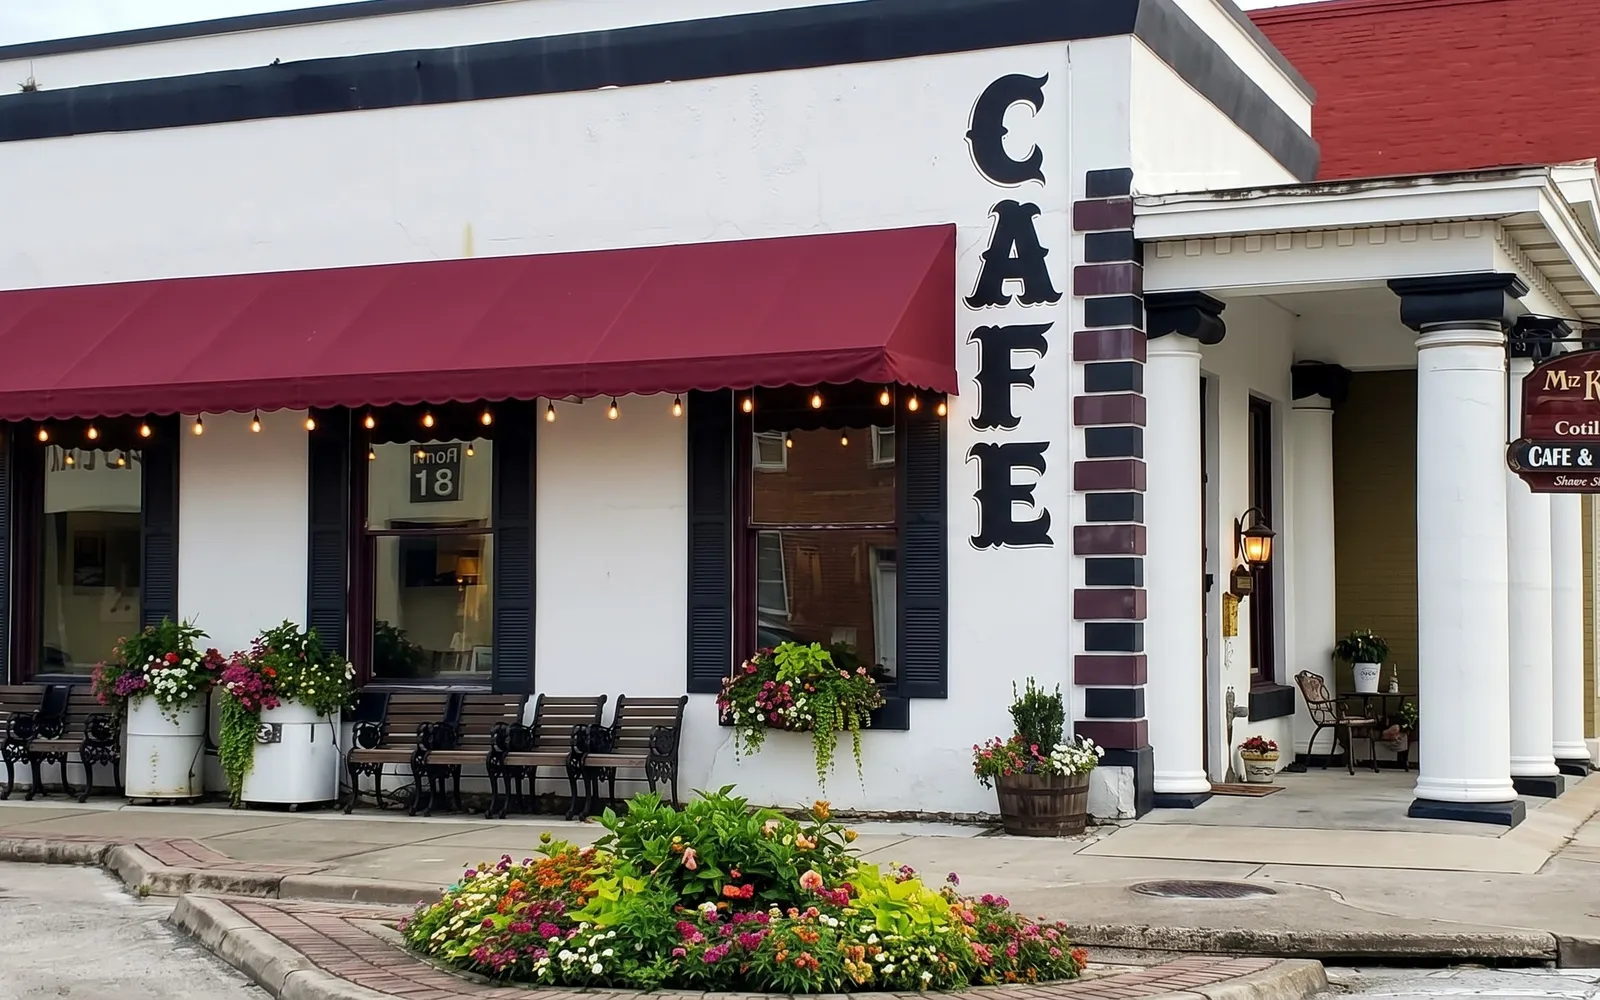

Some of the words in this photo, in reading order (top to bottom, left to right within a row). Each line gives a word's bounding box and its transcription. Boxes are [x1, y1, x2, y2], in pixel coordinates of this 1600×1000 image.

[963, 71, 1063, 551] CAFE
[1528, 445, 1572, 467] CAFE
[1577, 448, 1593, 466] &
